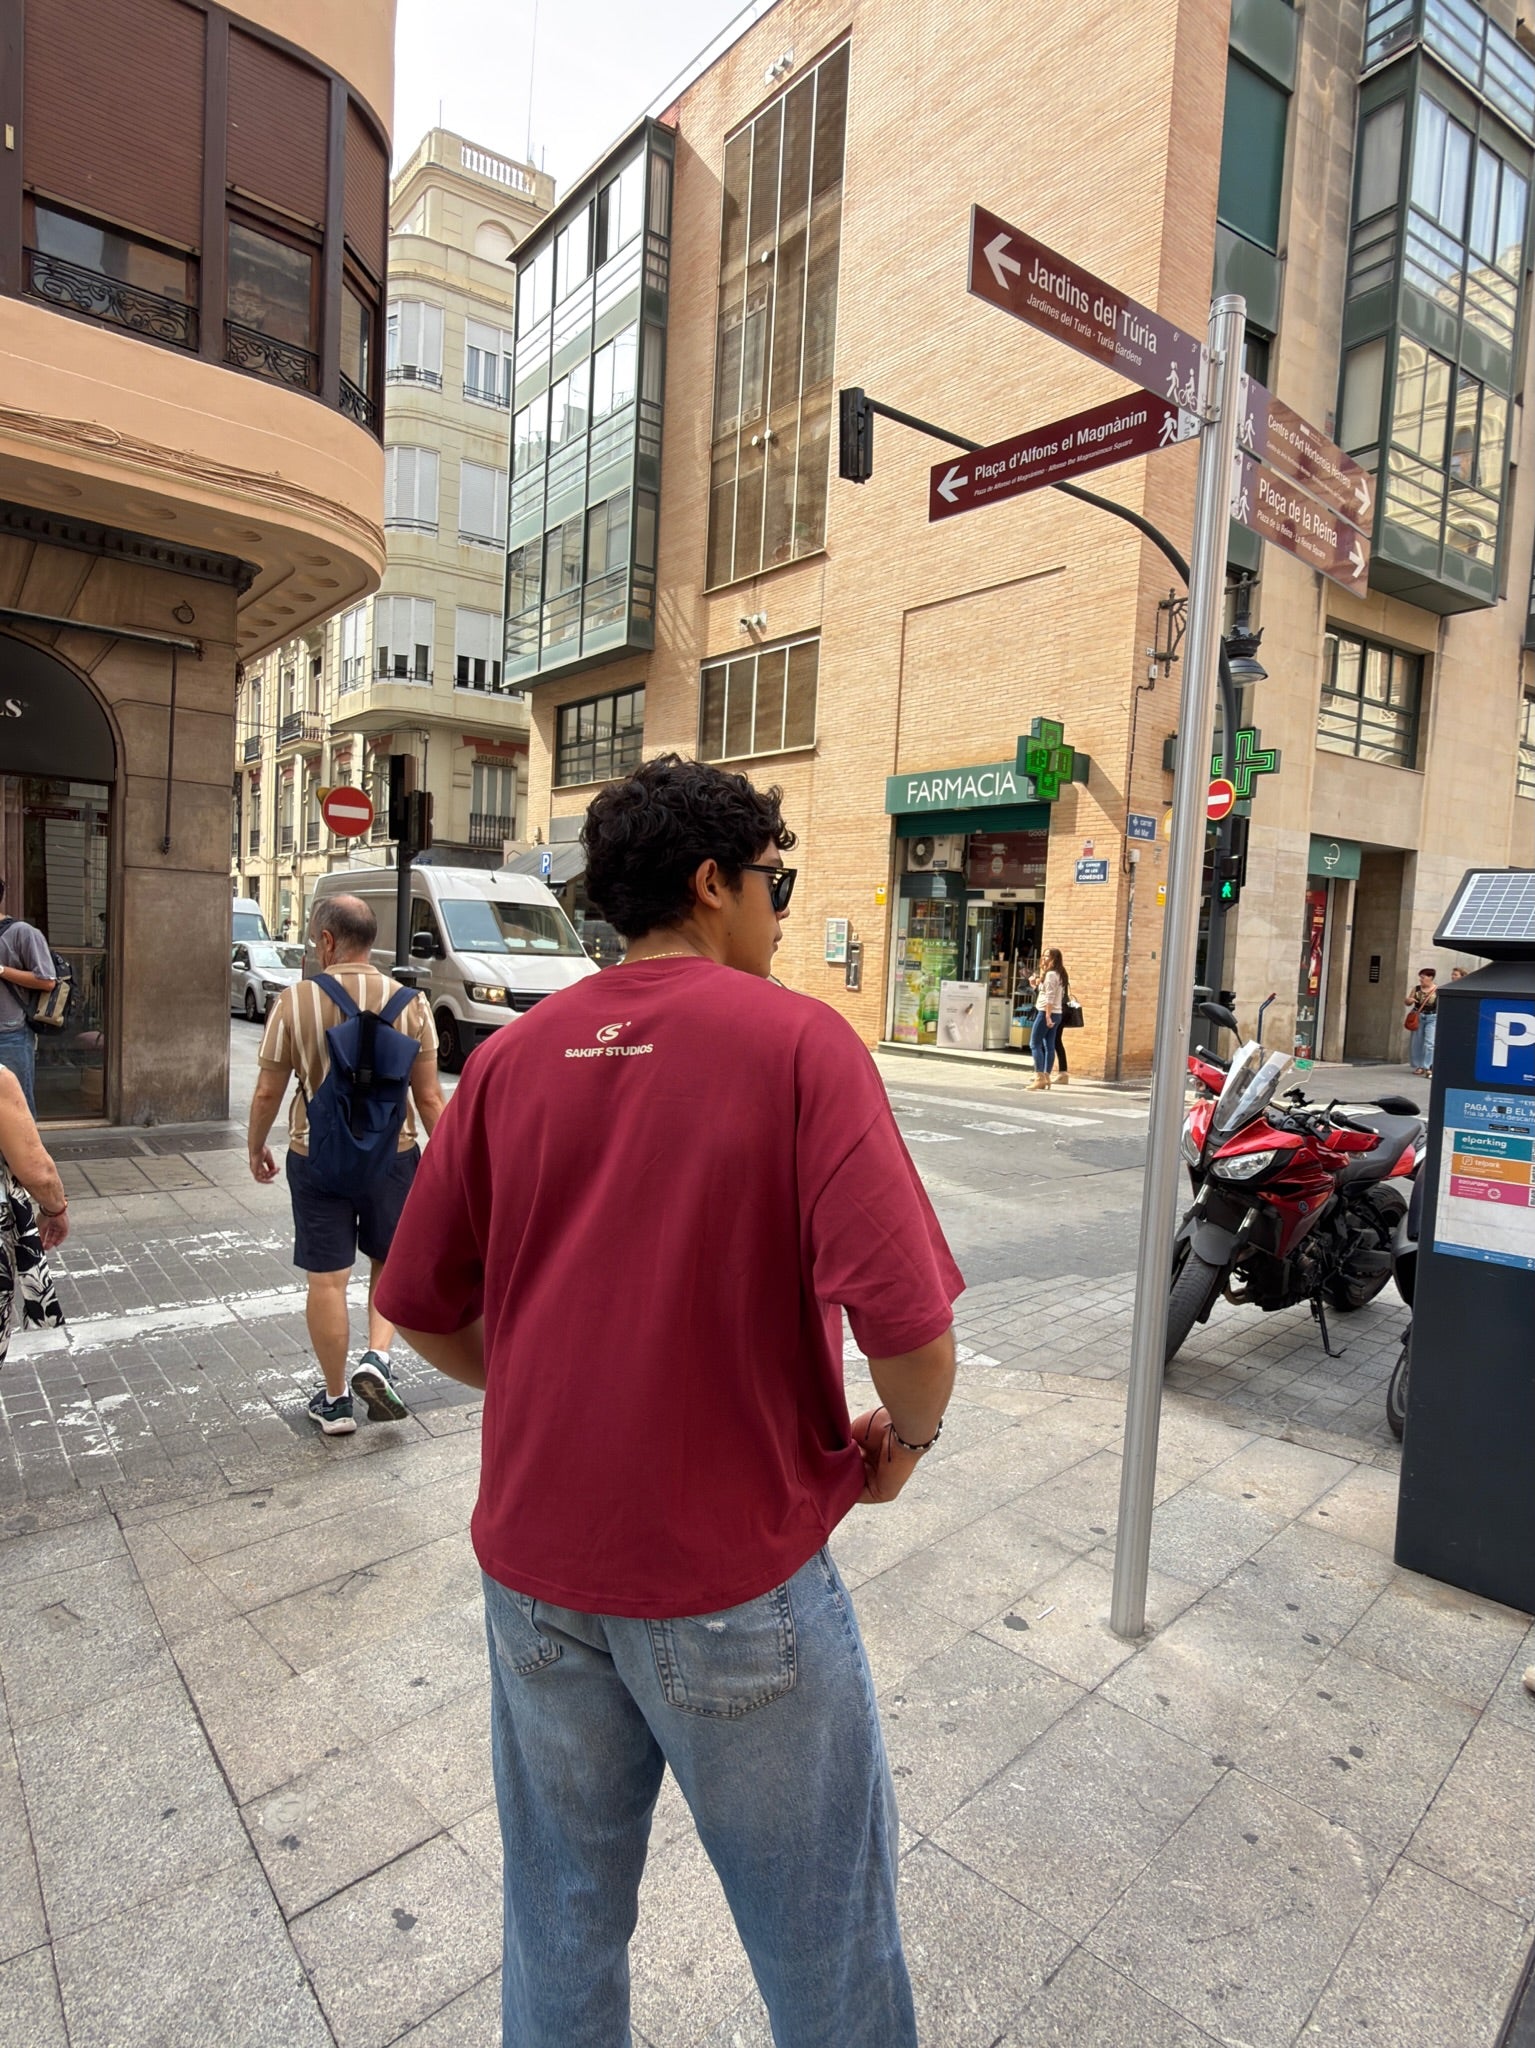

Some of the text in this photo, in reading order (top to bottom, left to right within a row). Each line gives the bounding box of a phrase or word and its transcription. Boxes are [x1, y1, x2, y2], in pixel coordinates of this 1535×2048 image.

[1028, 258, 1157, 354] Jardins del Túria
[1027, 293, 1059, 320] Jardines
[1060, 311, 1072, 323] del
[1115, 342, 1142, 367] Gardens
[1268, 414, 1289, 440] Centre
[974, 462, 1006, 481] Plaça
[1061, 436, 1073, 451] el
[1077, 410, 1147, 446] Magnànim
[1257, 509, 1269, 524] Plaza
[1269, 517, 1276, 527] de
[1259, 478, 1338, 547] Plaça de la Reina
[907, 771, 1017, 804] FARMACIA
[542, 855, 550, 873] P
[565, 1043, 654, 1058] SAKIFF STUDIOS
[1492, 1012, 1535, 1067] P
[1464, 1102, 1487, 1112] PAGA
[1491, 1106, 1512, 1115] AB
[1515, 1108, 1526, 1117] EL
[1462, 1136, 1507, 1149] elparking
